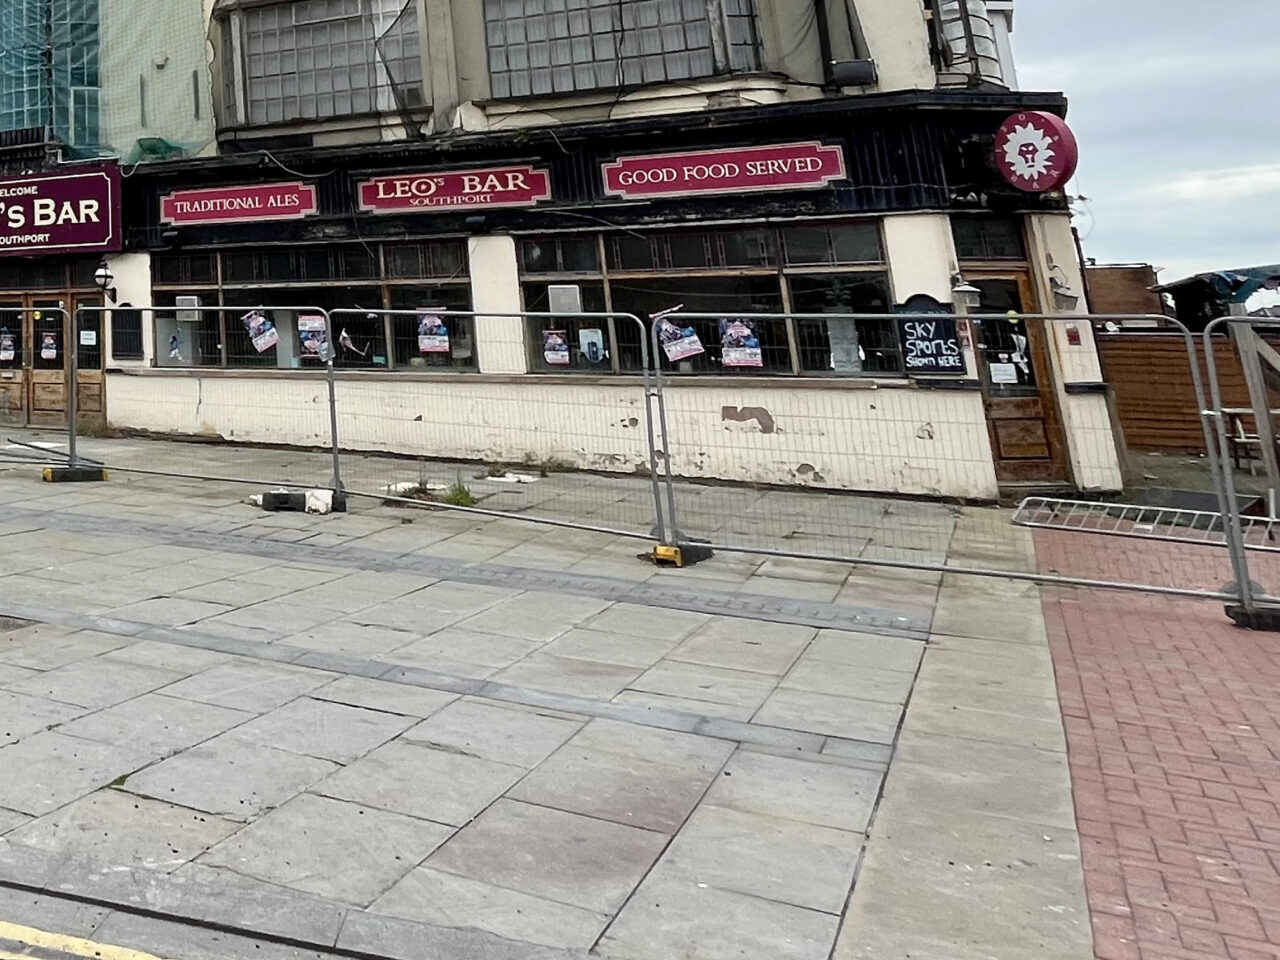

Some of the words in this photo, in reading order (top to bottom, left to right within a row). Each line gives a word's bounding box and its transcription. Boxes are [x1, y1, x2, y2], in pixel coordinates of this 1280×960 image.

[618, 168, 677, 185] GOOD
[682, 162, 740, 181] FOOD
[746, 157, 823, 177] SERVED
[376, 177, 445, 199] LEO'S
[461, 172, 530, 193] BAR
[174, 196, 263, 214] TRADITIONAL
[267, 193, 300, 208] ALES
[408, 193, 494, 206] SOUTHPORT
[33, 198, 100, 227] BAR
[904, 321, 936, 339] SKY
[937, 355, 962, 367] HERE
